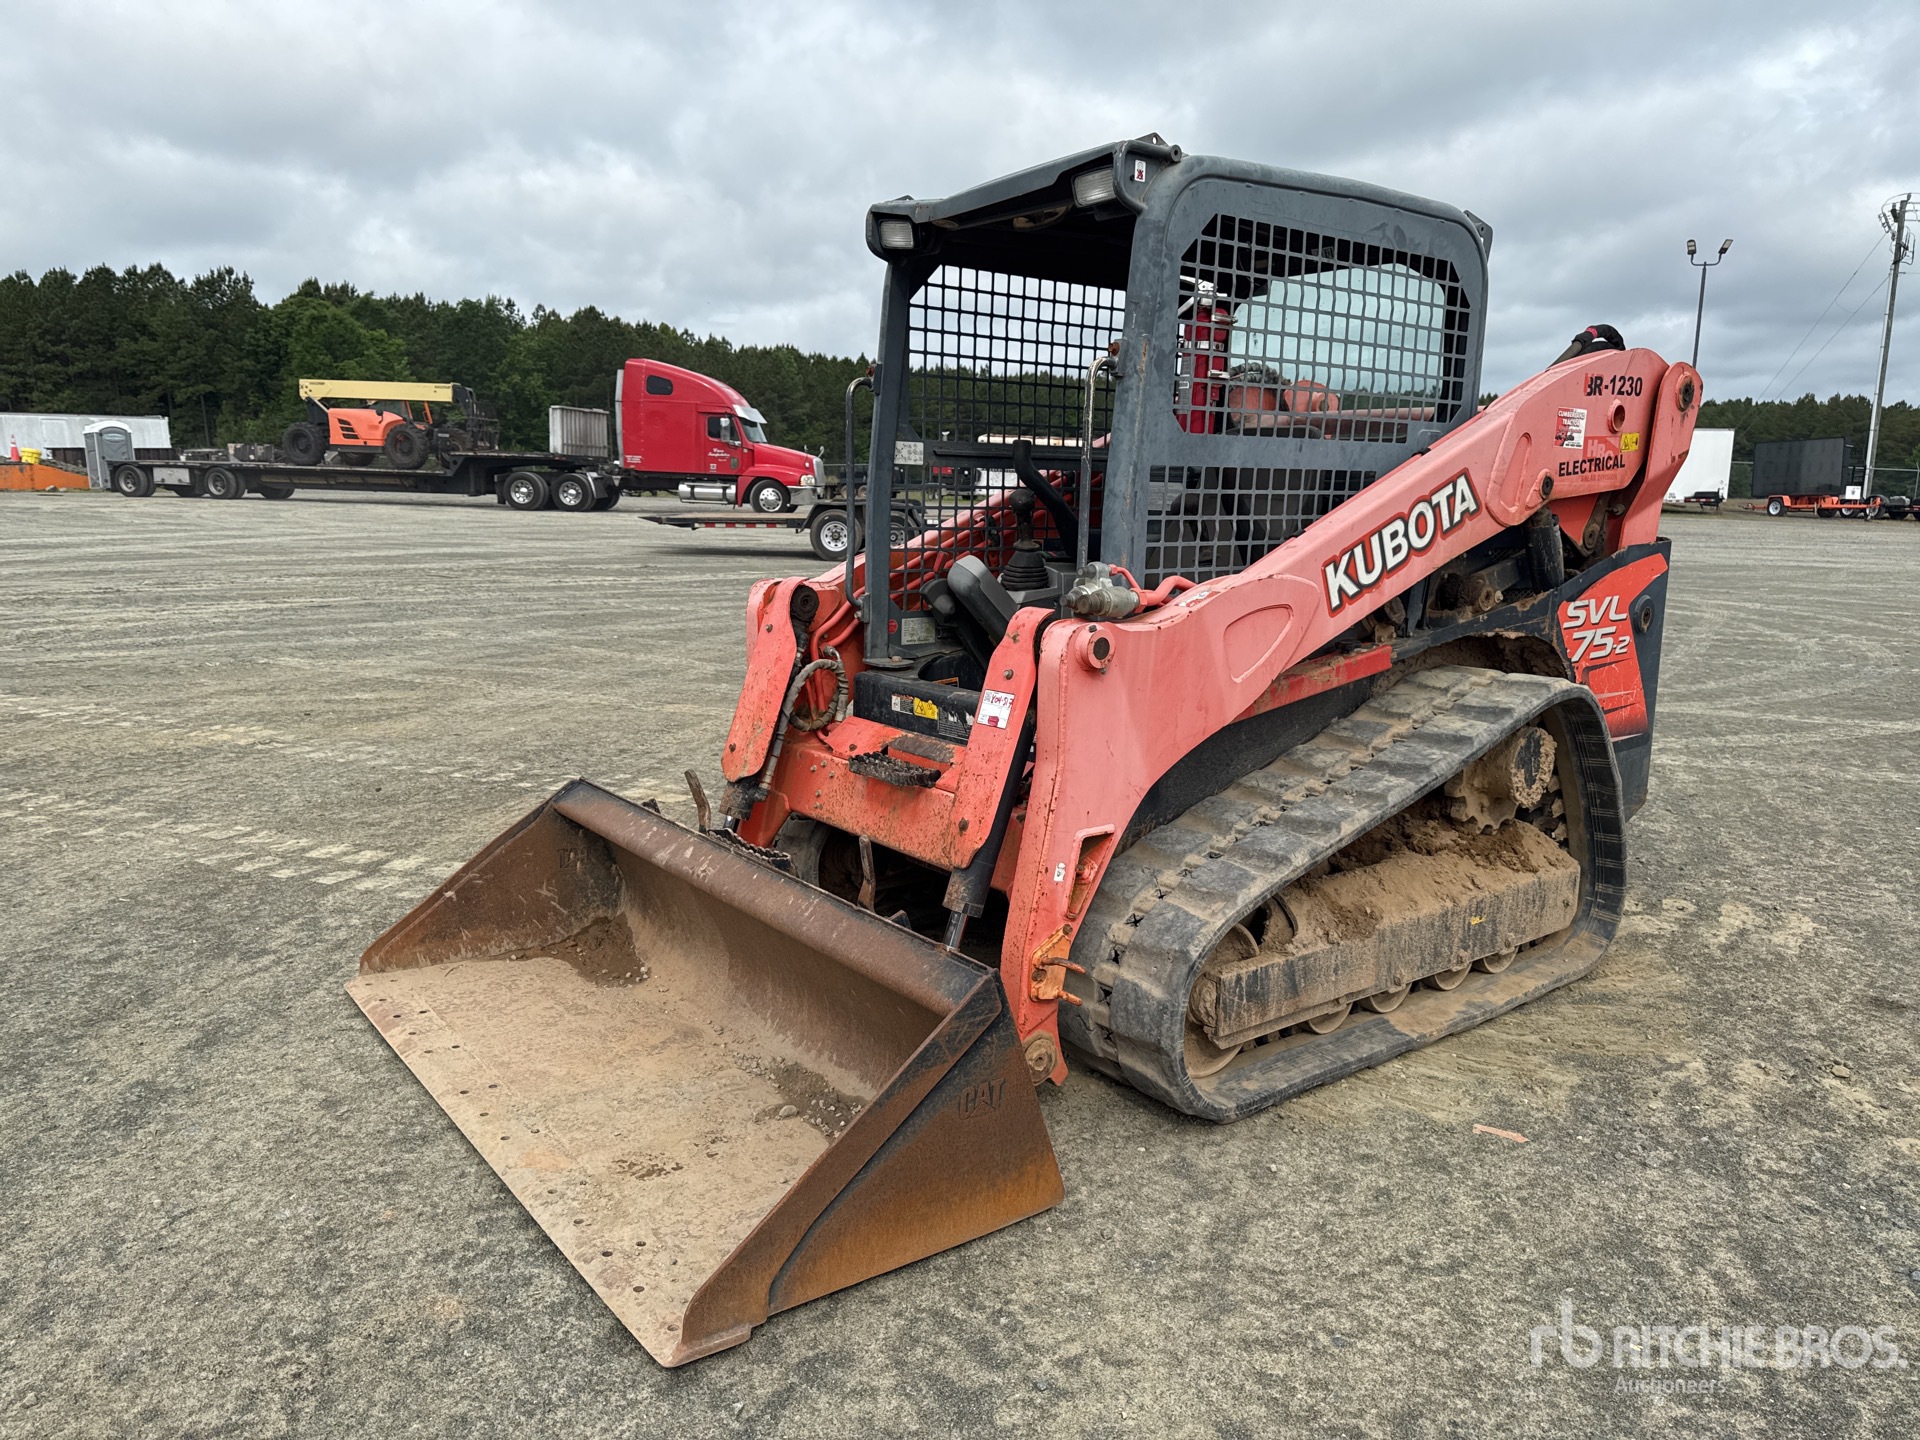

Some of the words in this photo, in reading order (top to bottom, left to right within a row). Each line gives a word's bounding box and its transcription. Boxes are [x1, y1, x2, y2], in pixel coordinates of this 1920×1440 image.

[1558, 453, 1626, 478] ELECTRICAL
[1324, 473, 1478, 611] KUBOTA
[1563, 595, 1629, 629] SVL
[1571, 626, 1631, 663] 75-2
[958, 1078, 1006, 1121] CAT
